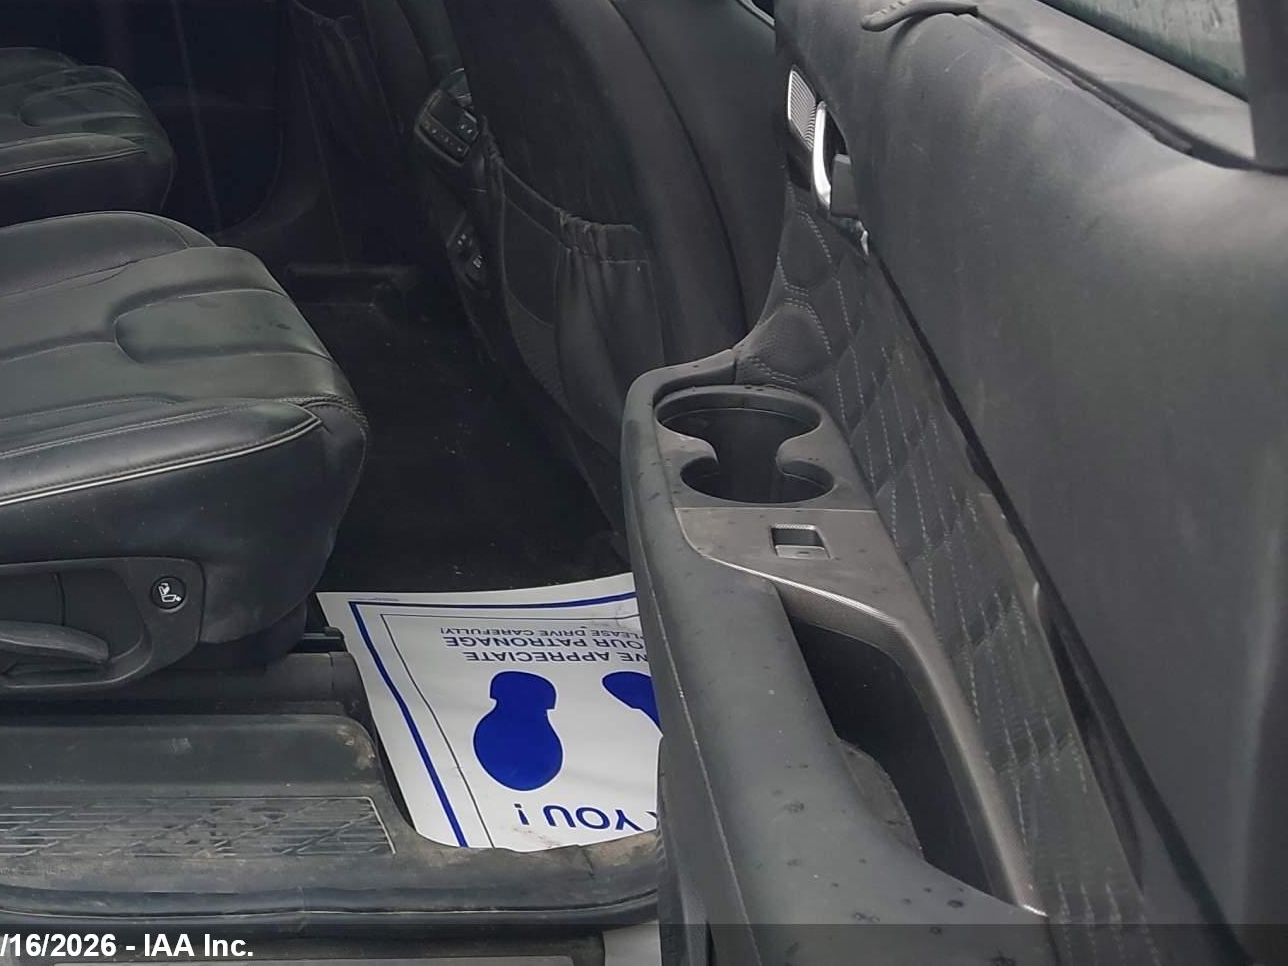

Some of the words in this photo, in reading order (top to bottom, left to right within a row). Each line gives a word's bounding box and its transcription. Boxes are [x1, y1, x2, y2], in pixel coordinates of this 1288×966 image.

[440, 627, 535, 636] CAREFULLY!
[539, 629, 587, 637] DRIVE
[442, 636, 588, 647] PATRONAGE
[462, 651, 610, 662] APPRECIATE
